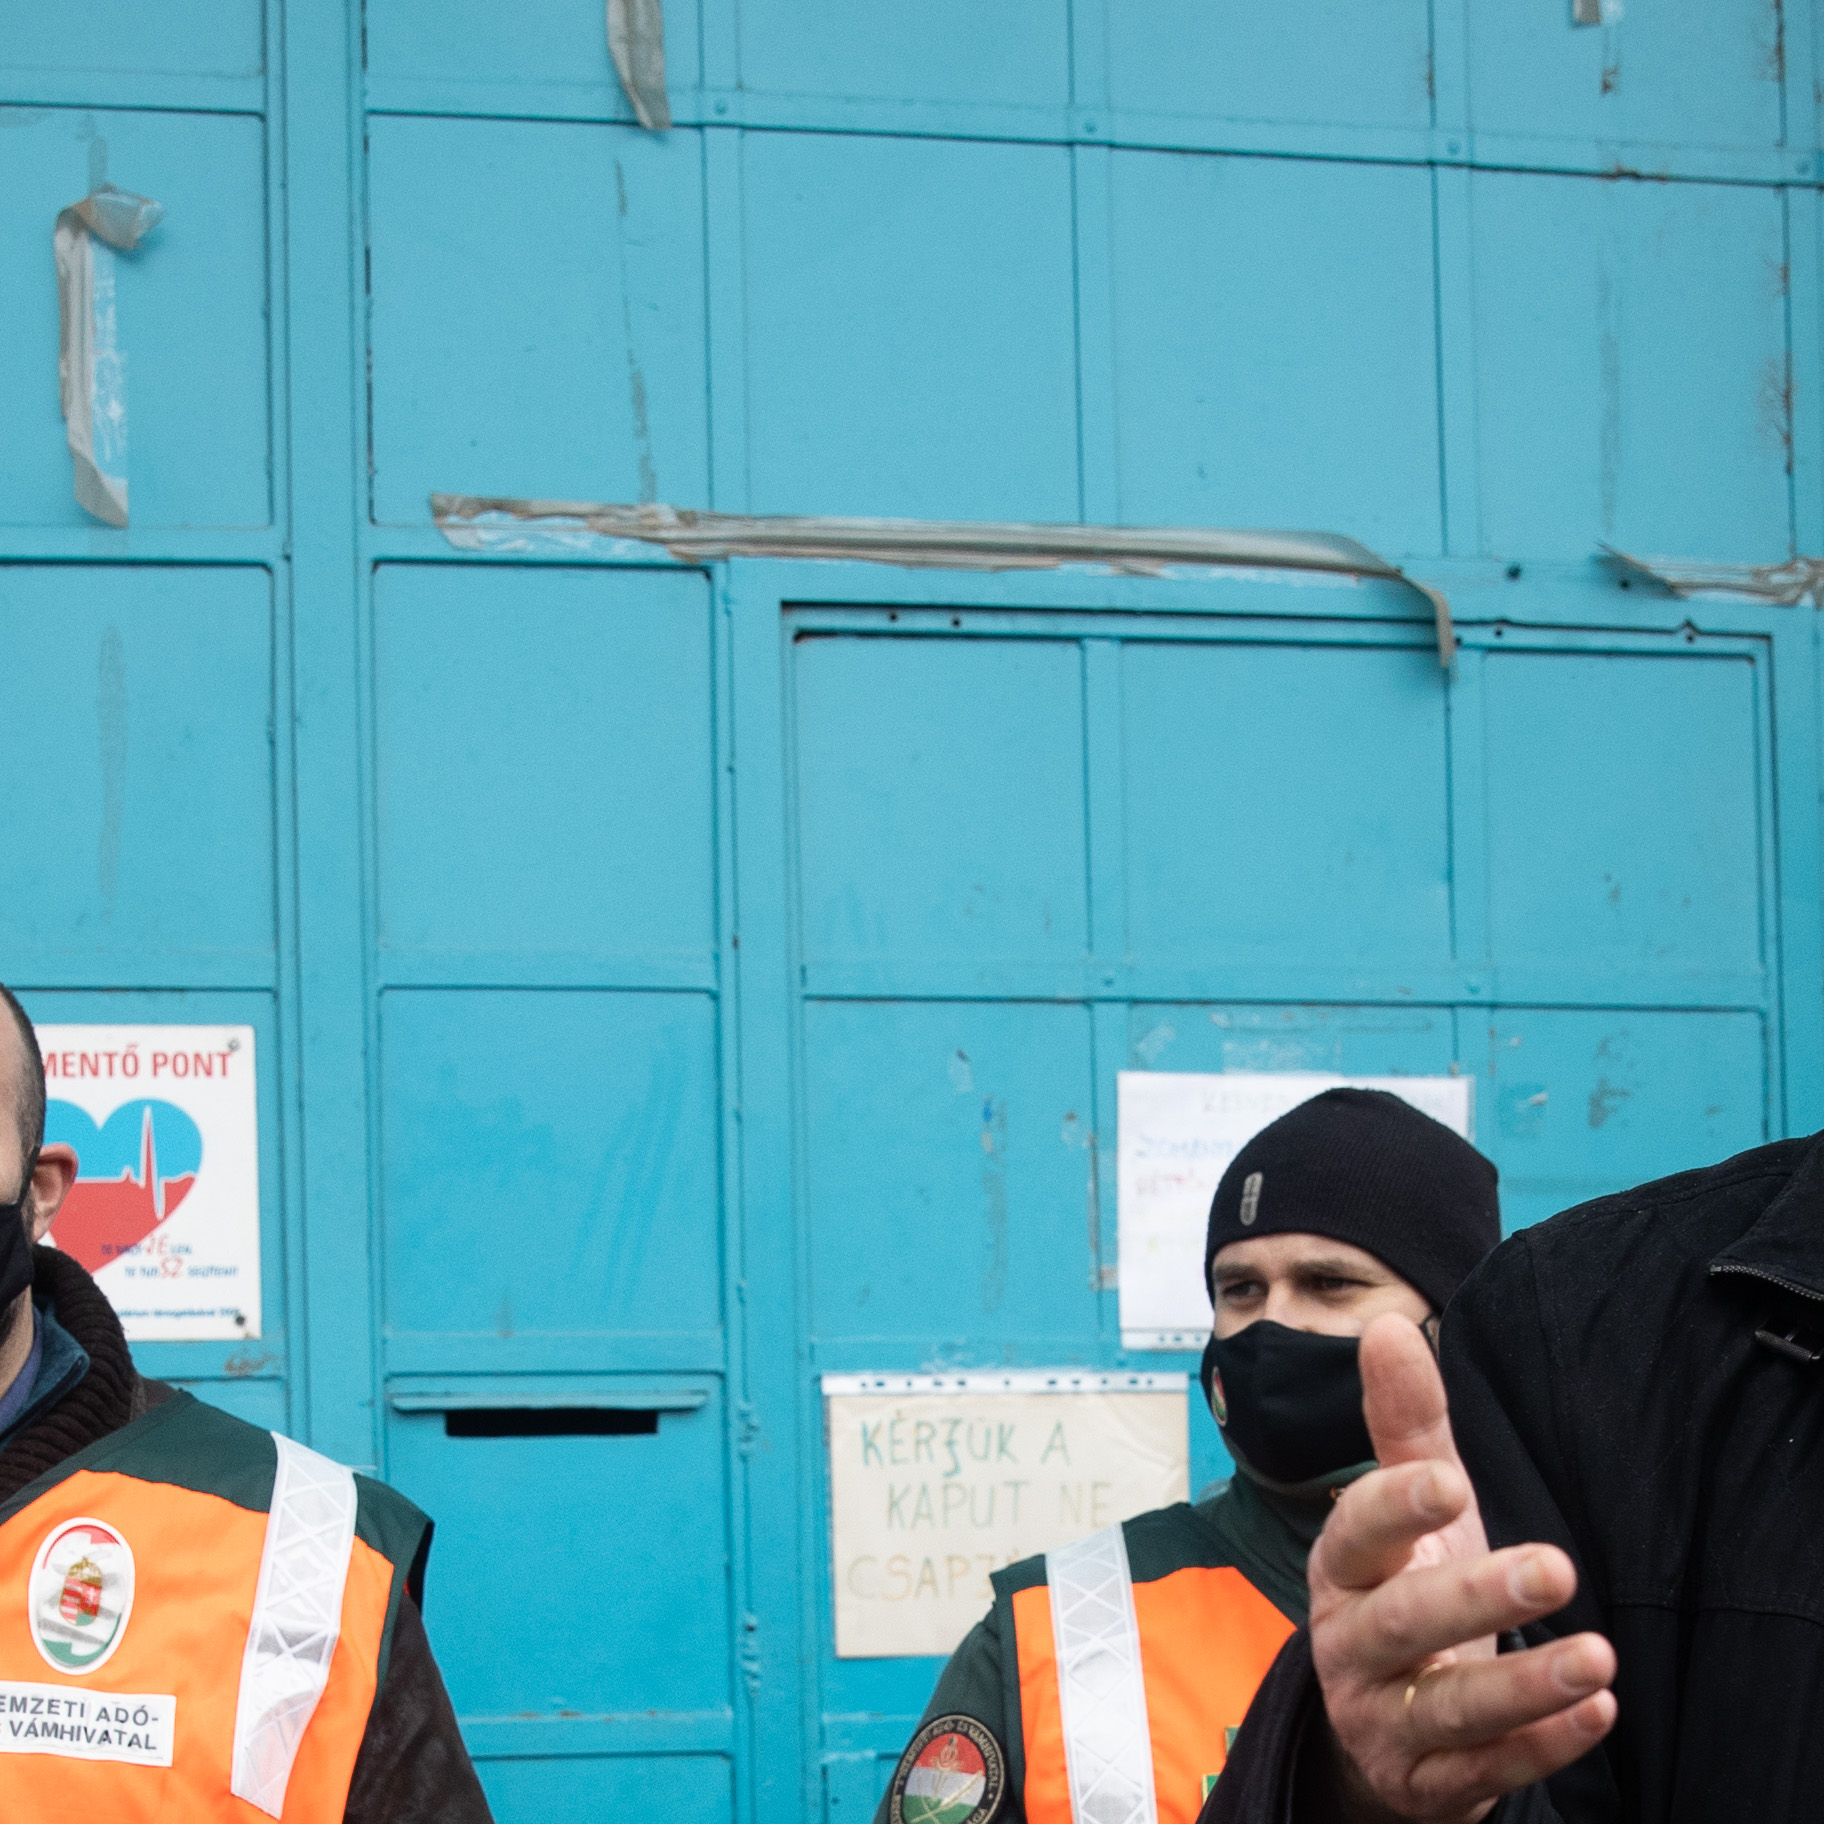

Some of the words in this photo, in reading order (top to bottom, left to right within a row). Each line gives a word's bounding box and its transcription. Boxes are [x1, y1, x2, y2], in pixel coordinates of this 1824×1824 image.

[151, 1050, 234, 1078] PONT
[1040, 1419, 1072, 1467] A
[886, 1480, 1030, 1531] KAPUT
[1059, 1481, 1114, 1531] NE
[95, 1705, 159, 1727] ADÓ-
[9, 1717, 158, 1751] VÁMHIVATAL
